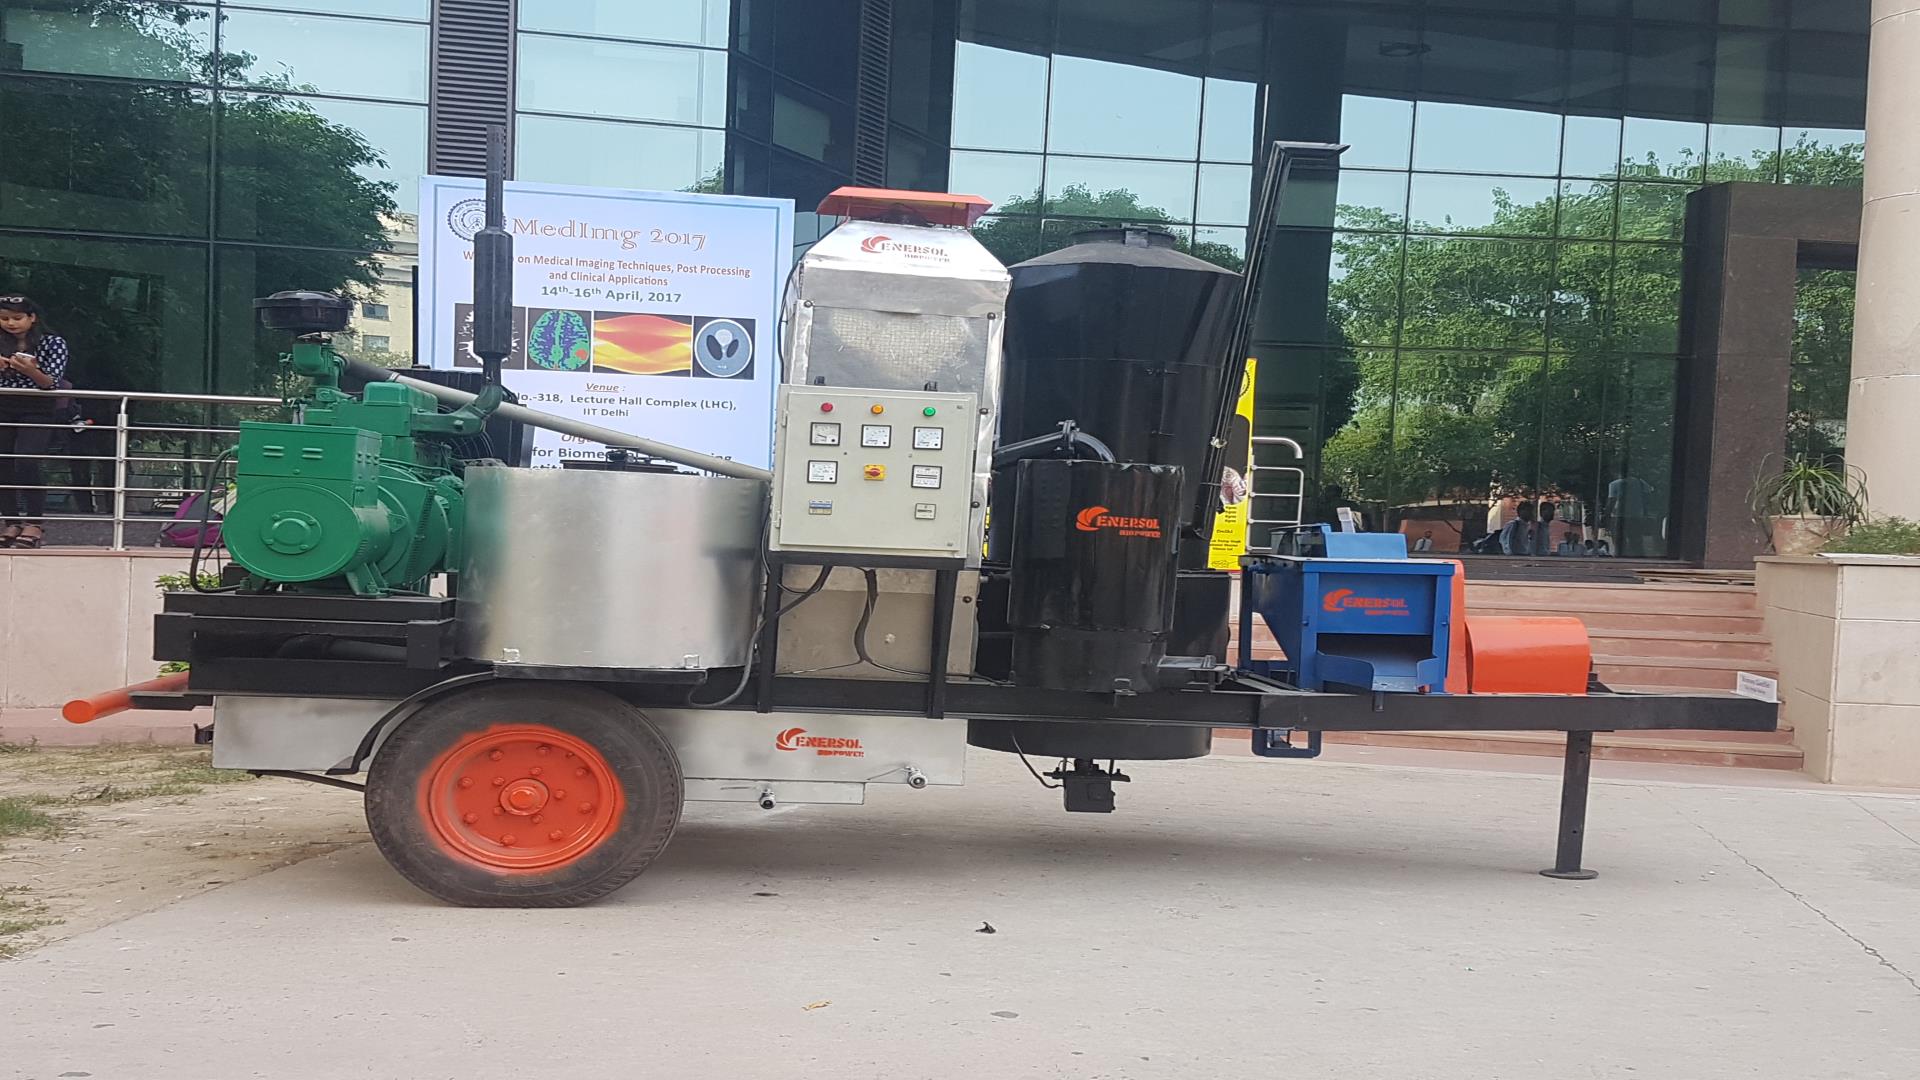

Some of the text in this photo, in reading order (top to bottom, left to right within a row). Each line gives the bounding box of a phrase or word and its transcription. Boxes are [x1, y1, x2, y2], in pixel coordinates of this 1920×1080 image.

[513, 218, 640, 250] MedImg
[650, 228, 706, 251] 2017
[881, 242, 948, 257] ENERSOL
[517, 255, 751, 278] on Medical Imaging Techniques, Post Processing
[549, 271, 668, 286] and Clinical Applications
[605, 289, 643, 303] April,
[648, 292, 682, 303] 2017
[586, 383, 620, 392] Venue
[570, 394, 615, 405] Lecture
[619, 396, 642, 406] Hall
[645, 397, 697, 409] Complex
[700, 399, 737, 411] (LHC),
[583, 408, 629, 417] IIT Delhi
[531, 446, 554, 457] for
[1095, 515, 1160, 529] ENERSOL
[795, 736, 863, 749] ENERSOL
